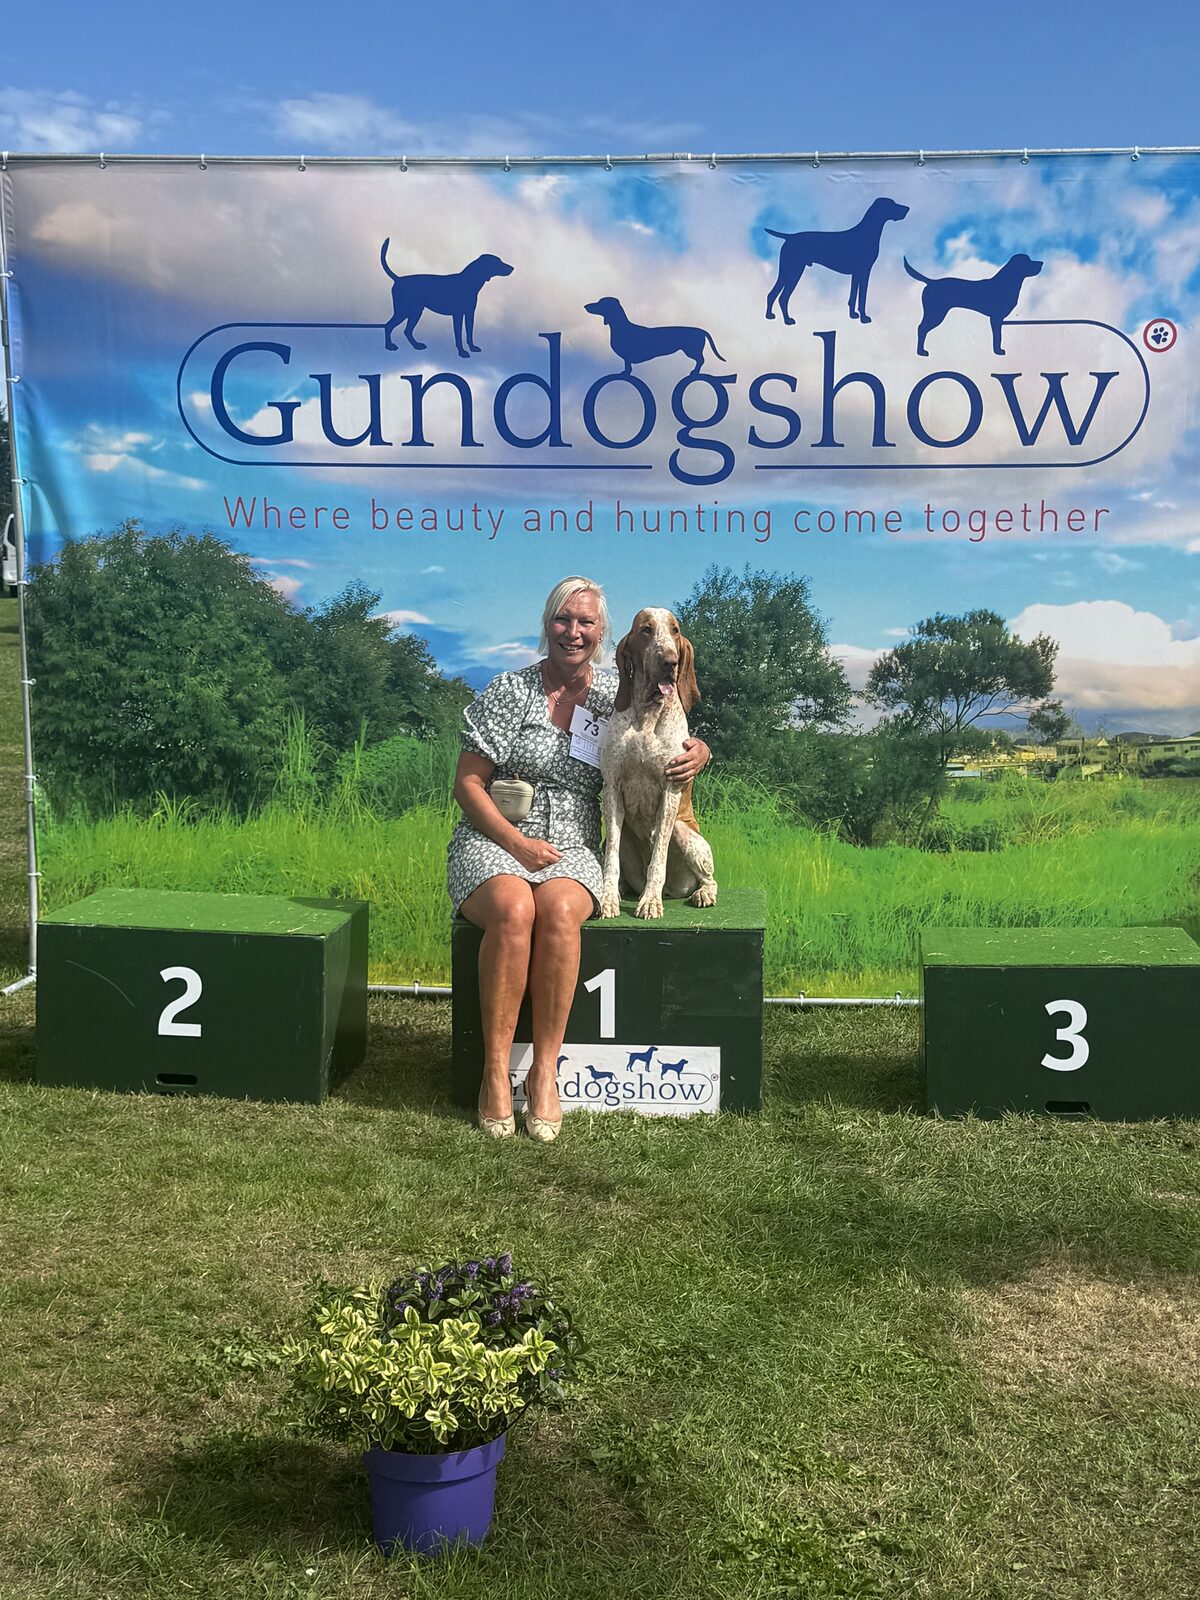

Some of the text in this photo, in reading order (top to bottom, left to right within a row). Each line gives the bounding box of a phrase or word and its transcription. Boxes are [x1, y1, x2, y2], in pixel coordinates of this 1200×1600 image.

[210, 331, 1120, 486] Gundogshow
[223, 496, 1110, 543] Where beauty and hunting come together
[584, 718, 600, 737] 73
[157, 966, 203, 1037] 2
[583, 968, 616, 1039] 1
[1040, 999, 1090, 1072] 3
